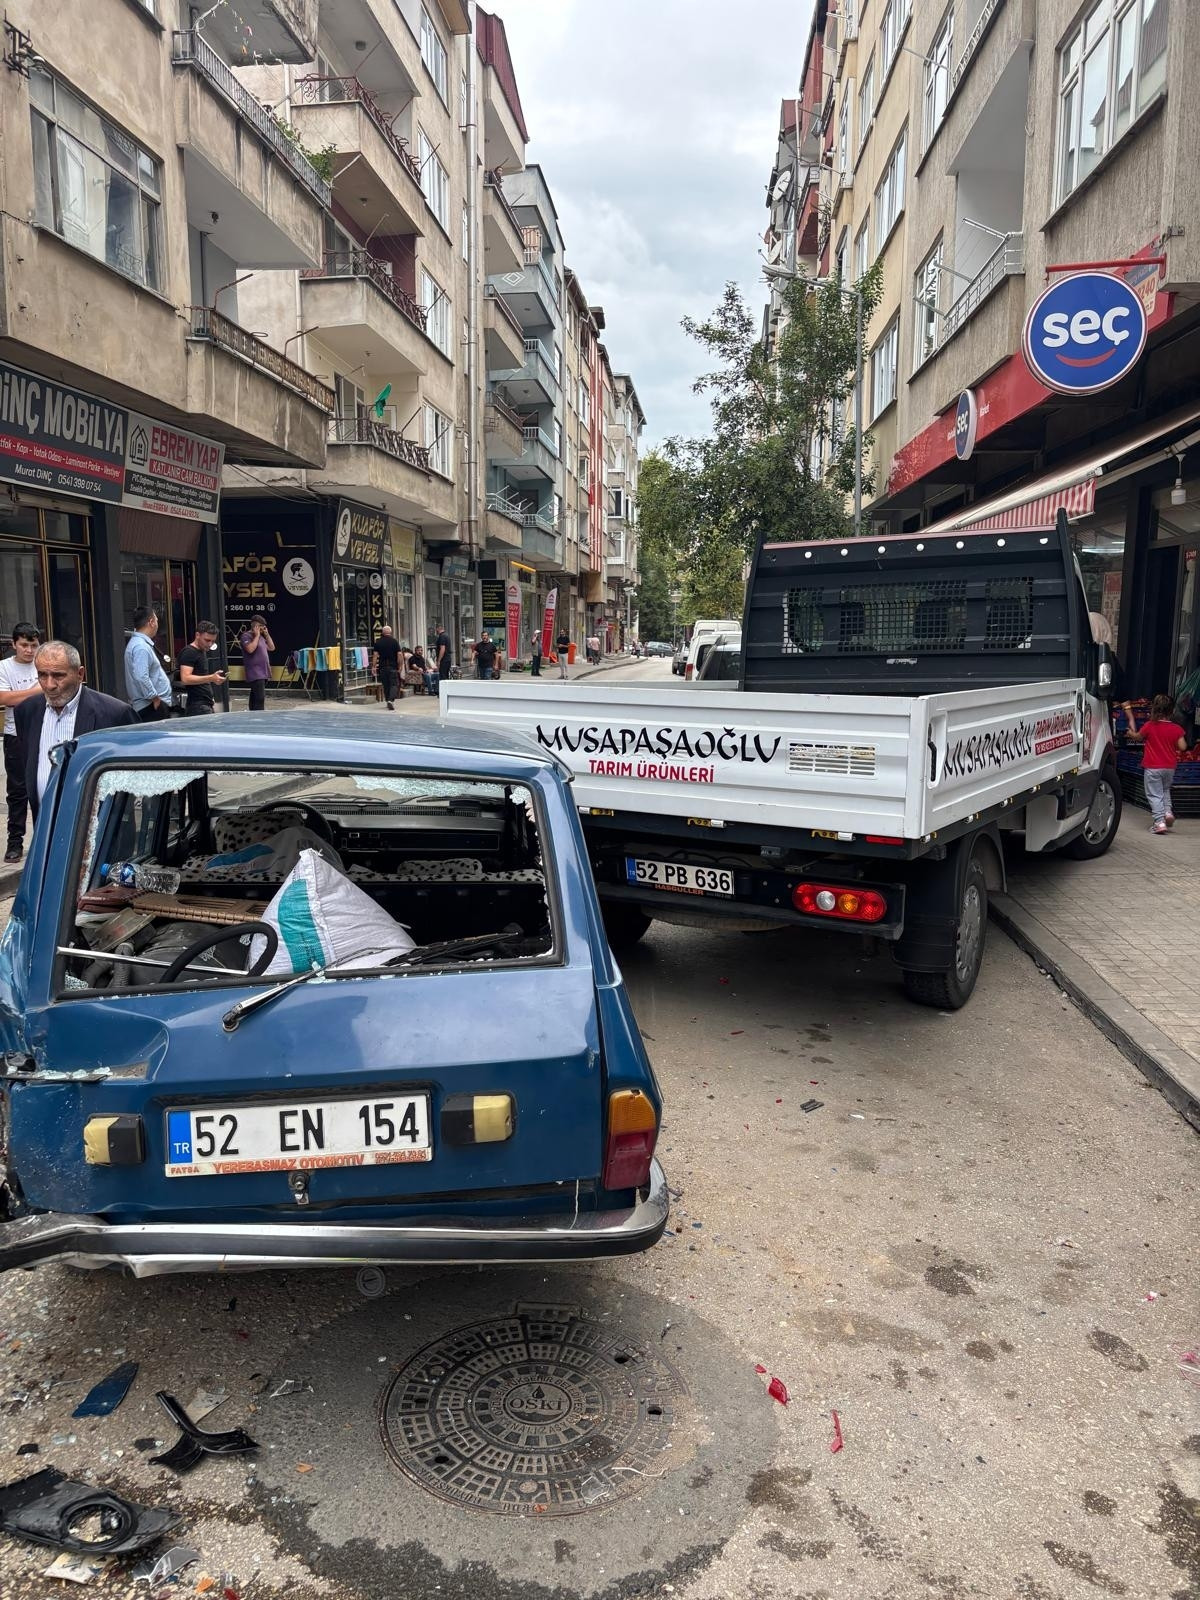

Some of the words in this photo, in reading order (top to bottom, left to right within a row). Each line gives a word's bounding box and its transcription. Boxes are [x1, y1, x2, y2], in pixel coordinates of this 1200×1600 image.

[1042, 306, 1130, 348] seç
[957, 410, 968, 435] seç
[150, 426, 194, 466] EBREM
[196, 442, 220, 473] YAPI
[15, 463, 35, 477] Murat
[181, 469, 193, 483] CAM
[351, 512, 385, 539] KUAFÖR
[351, 539, 379, 564] VEYSEL
[589, 760, 632, 776] TARIM
[637, 762, 715, 783] ÜRÜNLERİ
[636, 861, 659, 882] 52
[665, 865, 688, 885] PB
[695, 869, 731, 892] 636
[195, 1114, 239, 1157] 52
[279, 1108, 325, 1152] EN
[359, 1102, 420, 1147] 154
[173, 1142, 190, 1155] TR
